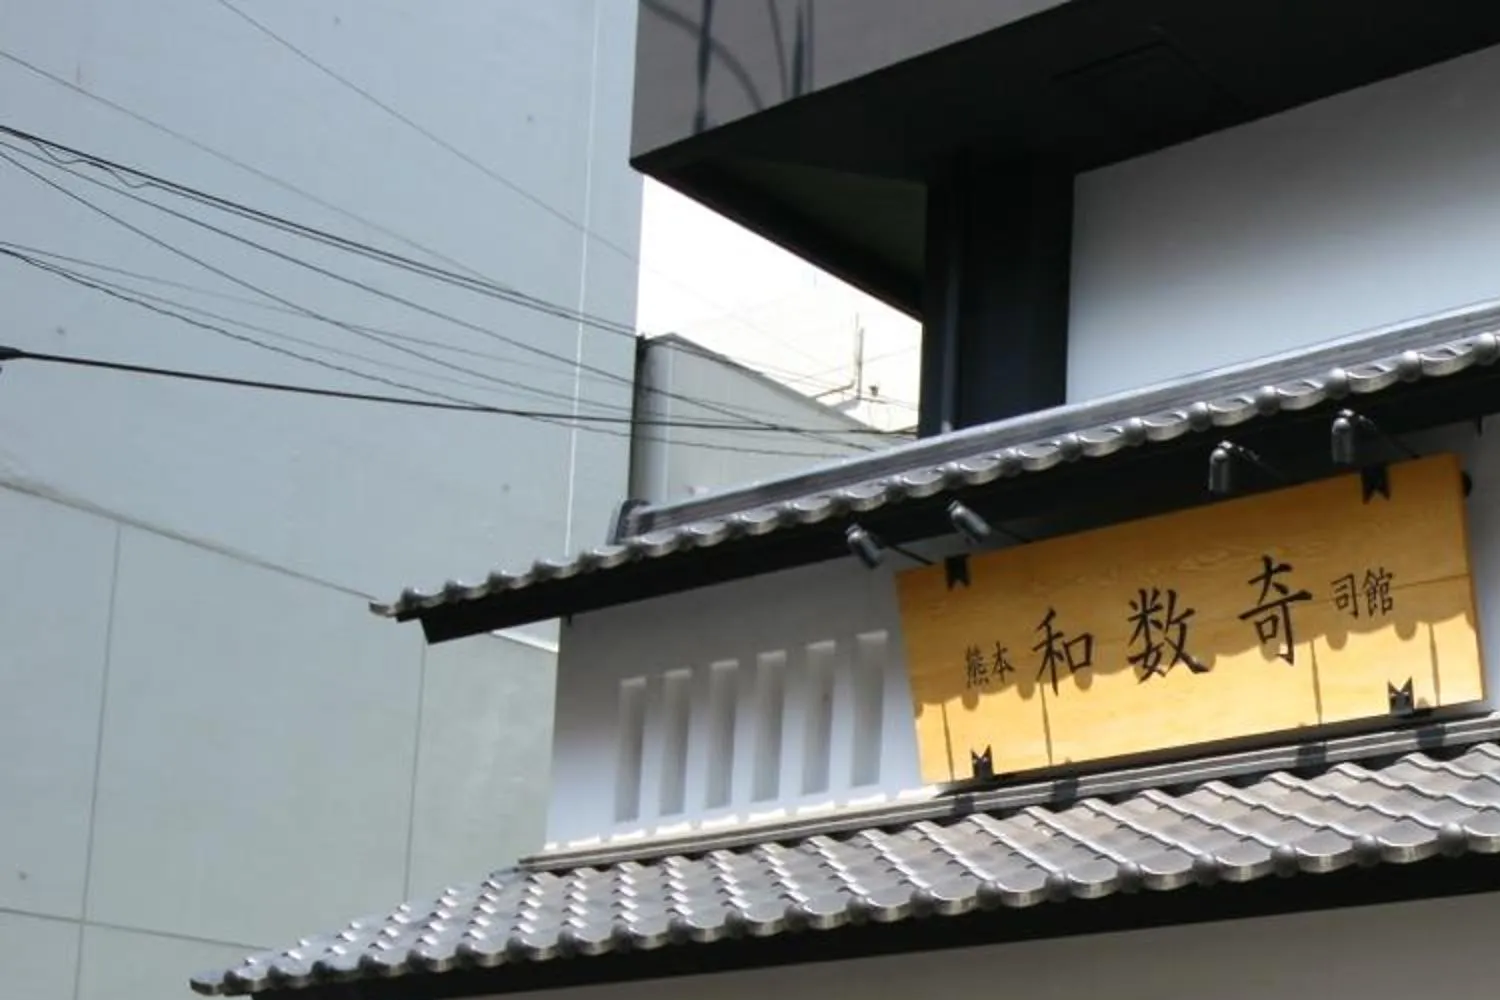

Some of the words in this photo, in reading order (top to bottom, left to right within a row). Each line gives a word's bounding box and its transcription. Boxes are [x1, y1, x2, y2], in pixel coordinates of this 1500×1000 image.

[964, 640, 1016, 690] 熊本
[1032, 555, 1313, 696] 和数奇
[1330, 566, 1395, 619] 司館
